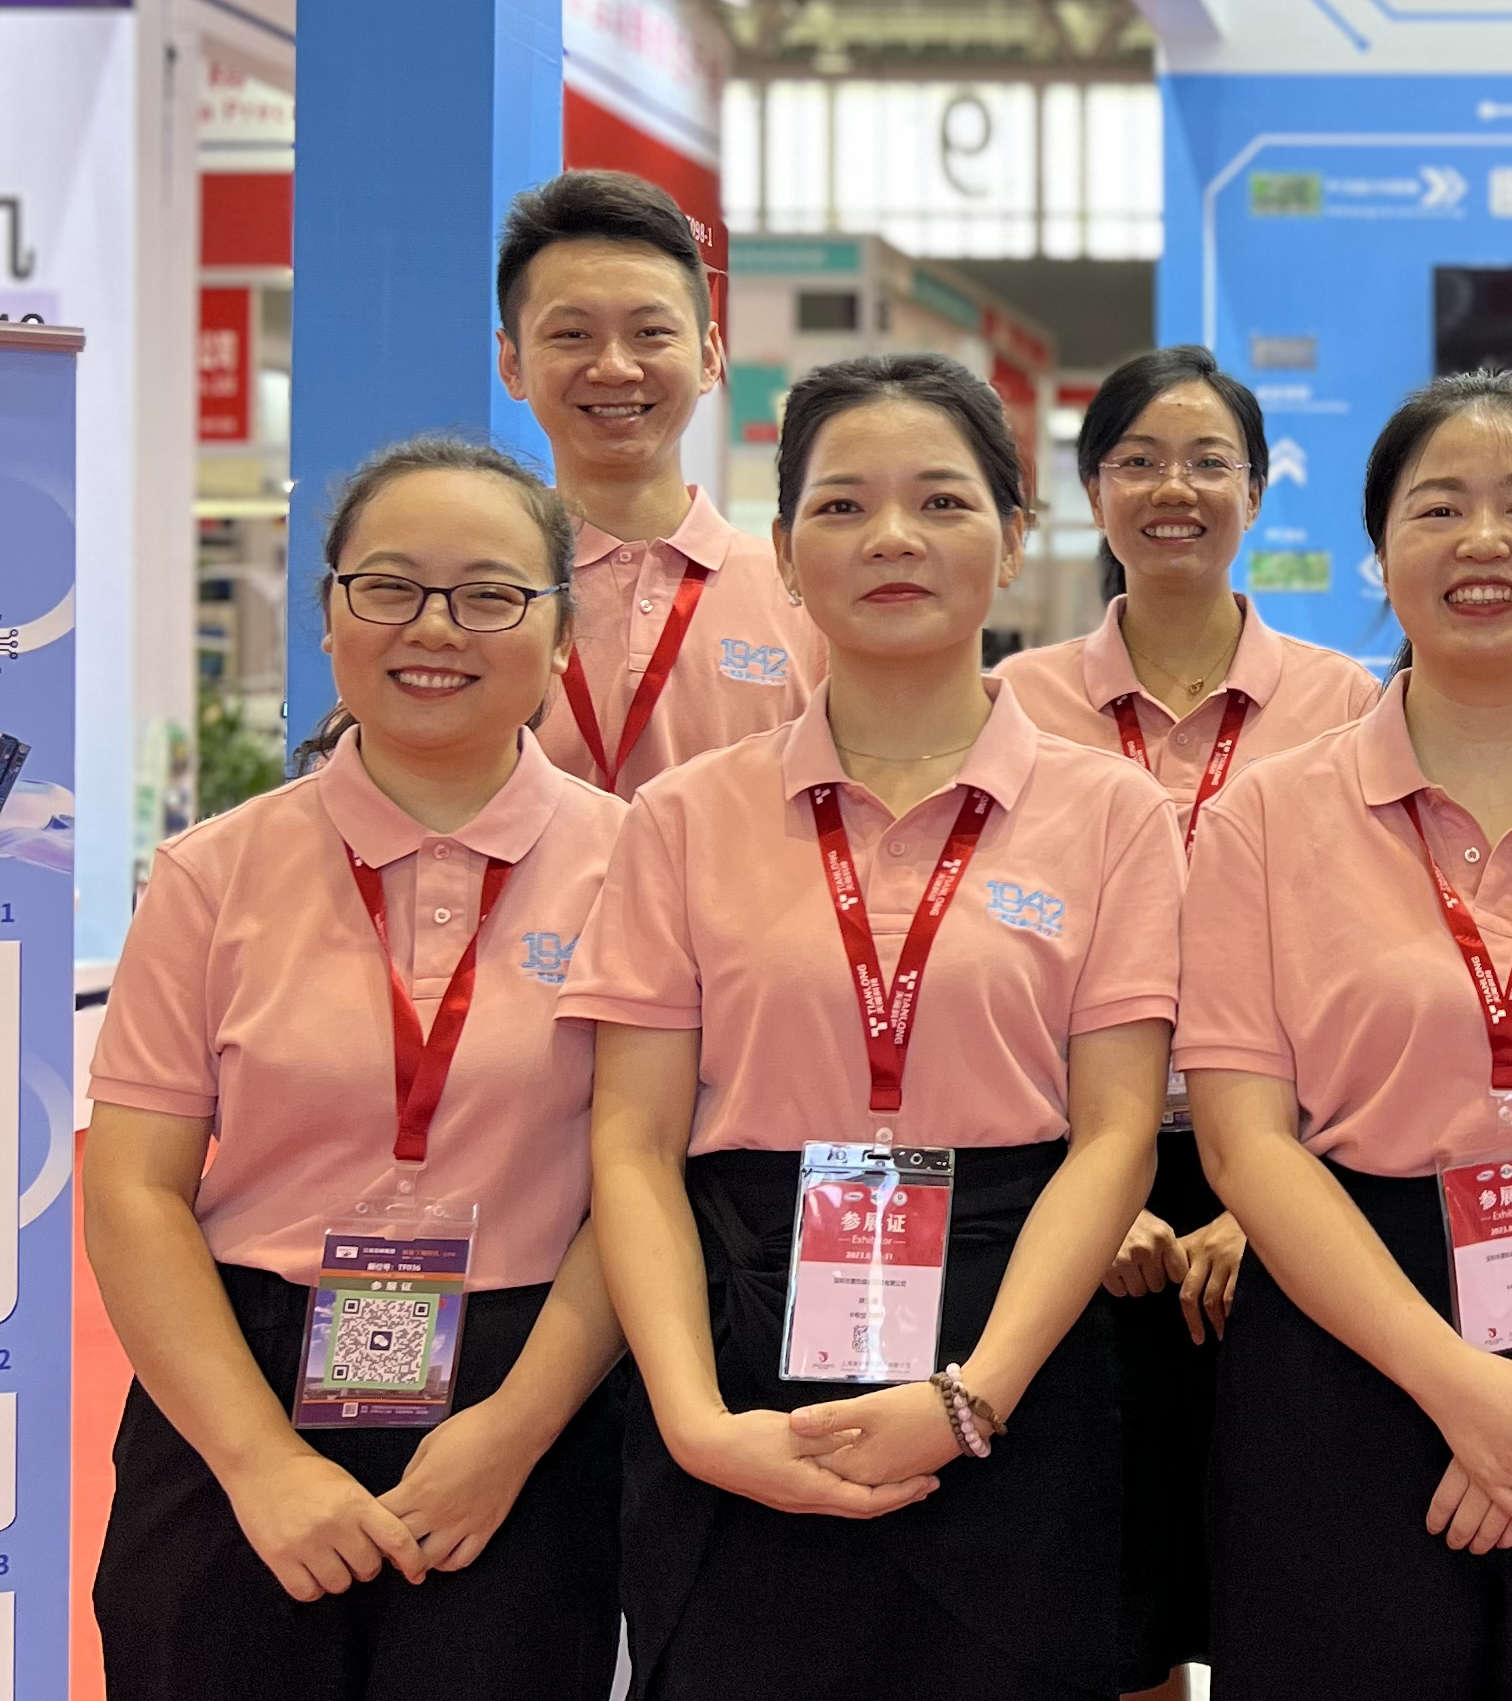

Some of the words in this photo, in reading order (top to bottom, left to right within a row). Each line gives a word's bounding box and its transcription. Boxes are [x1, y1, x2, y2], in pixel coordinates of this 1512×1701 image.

[720, 638, 788, 676] 1942
[986, 881, 1064, 931] 1942
[520, 932, 581, 970] 194
